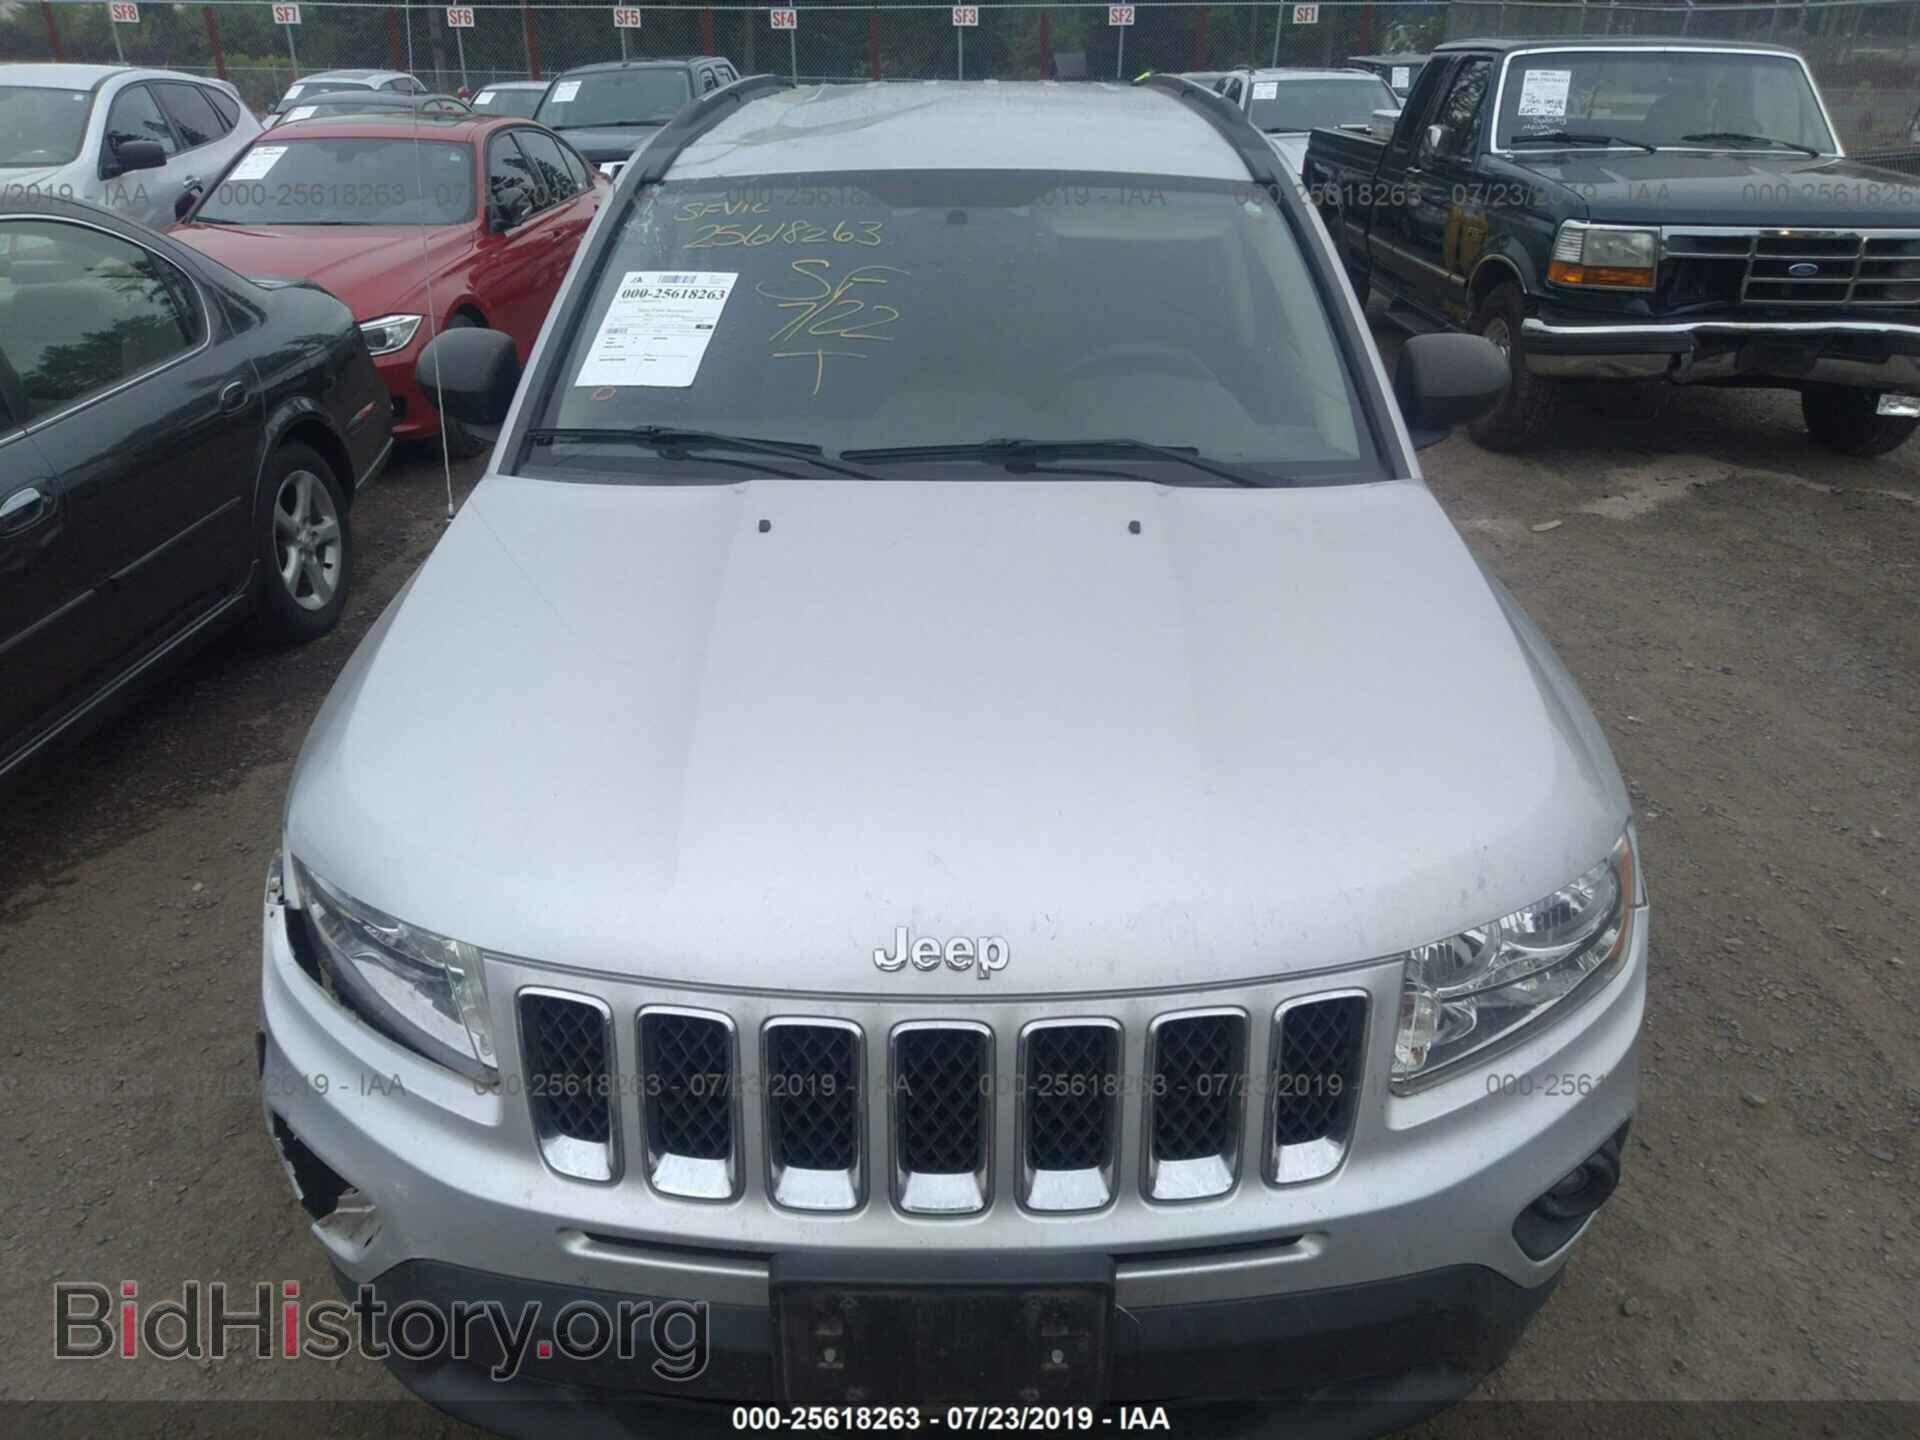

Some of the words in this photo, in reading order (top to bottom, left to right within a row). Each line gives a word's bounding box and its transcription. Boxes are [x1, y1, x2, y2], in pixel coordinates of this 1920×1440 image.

[112, 5, 138, 21] SF8
[275, 6, 297, 22] SF7
[449, 9, 473, 25] SF6
[615, 9, 640, 26] SF5
[772, 11, 796, 27] SF4
[954, 8, 977, 24] SF3
[1110, 8, 1133, 23] SF2
[682, 220, 883, 249] 25618263
[621, 286, 727, 301] 000-25618263
[772, 349, 869, 395] T
[872, 925, 1010, 980] Jeep
